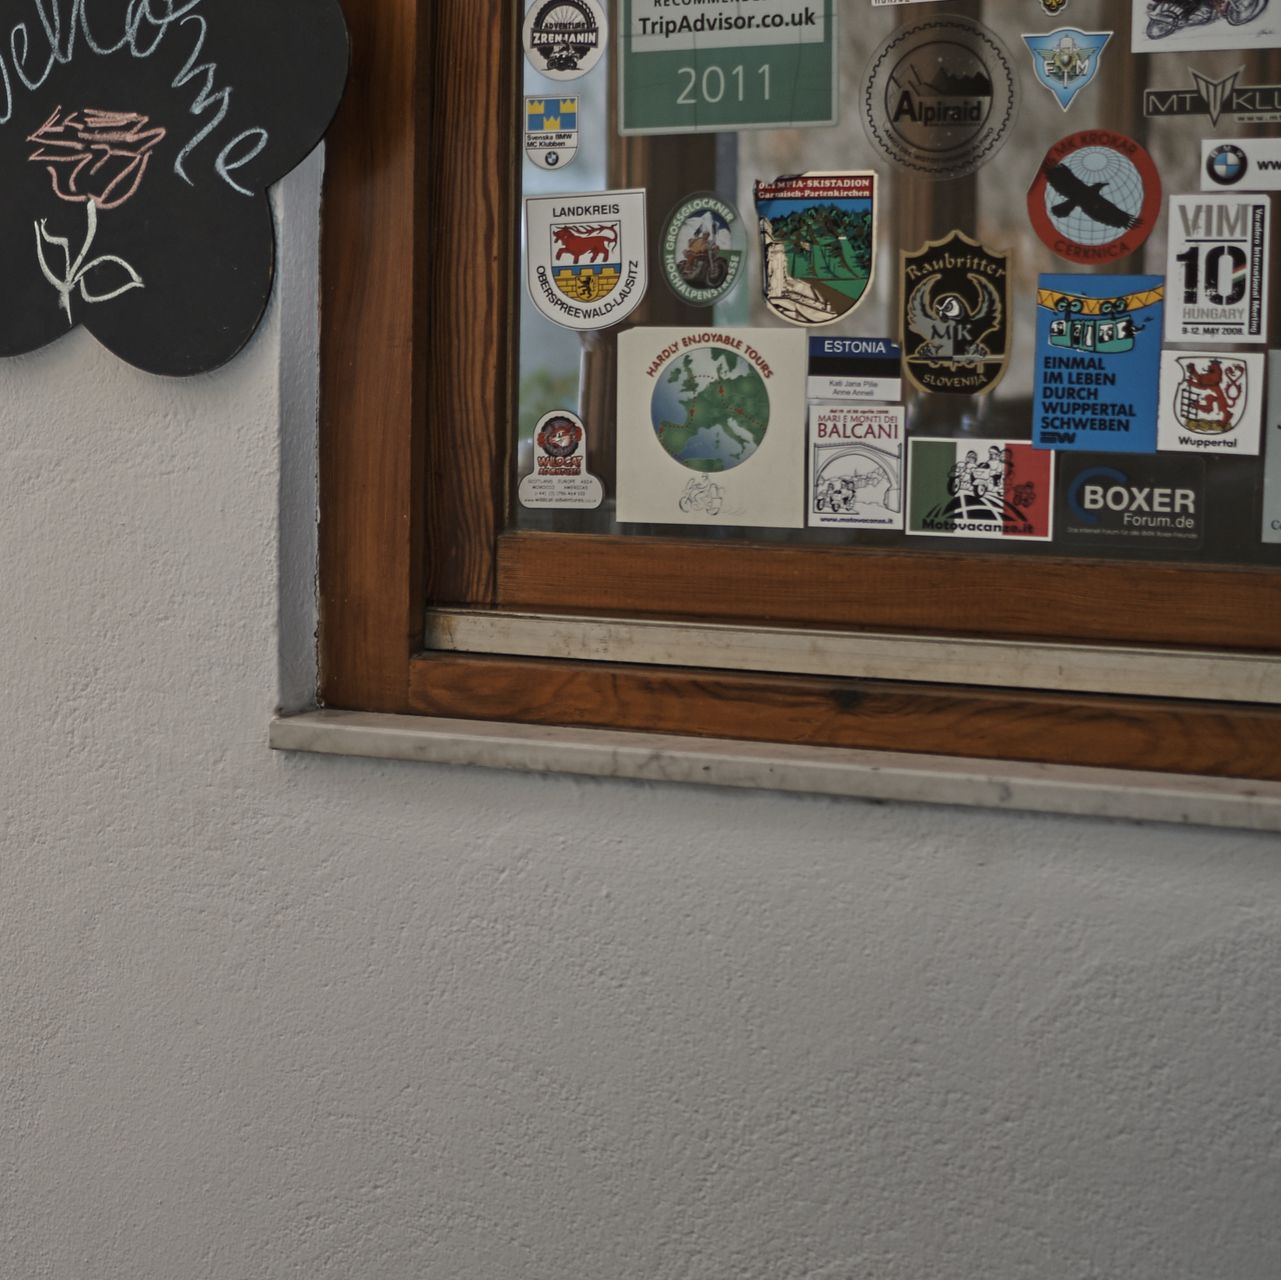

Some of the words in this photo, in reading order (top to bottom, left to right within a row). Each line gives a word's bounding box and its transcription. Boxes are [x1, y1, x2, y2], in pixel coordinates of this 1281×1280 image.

[544, 22, 588, 30] ADVENTURE
[638, 7, 817, 39] TripAdvisor.co.uk
[675, 63, 772, 106] 2011
[892, 90, 982, 127] Alpiraid
[1148, 92, 1199, 113] MT
[552, 204, 621, 218] LANDKREIS
[665, 197, 735, 250] GROSSGLOCKNER
[1178, 203, 1250, 238] VIM
[1253, 207, 1264, 245] Varadero
[1054, 240, 1131, 258] CERKNICA
[906, 253, 1007, 281] Raubritter
[1176, 245, 1248, 306] 10
[1251, 245, 1263, 300] International
[664, 254, 741, 302] HOCHALPENSTRASSE
[536, 260, 639, 320] OBERSPREEWALD-LAUSITZ
[1182, 307, 1246, 321] HUNGARY
[1249, 300, 1261, 334] Meeting
[930, 323, 974, 342] MK
[1202, 327, 1221, 336] MAY
[646, 341, 679, 378] HARDLY
[681, 332, 744, 350] ENJOYABLE
[744, 345, 775, 380] TOURS
[823, 340, 887, 354] ESTONIA
[1043, 356, 1106, 371] EINMAL
[1043, 371, 1063, 384] IM
[1067, 372, 1117, 386] LEBEN
[1042, 387, 1099, 400] DURCH
[1041, 402, 1137, 417] WUPPERTAL
[817, 422, 898, 439] BALCANI
[1040, 416, 1130, 432] SCHWEBEN
[1178, 436, 1238, 449] Wuppertal
[537, 455, 584, 468] WILDCAT
[1083, 485, 1197, 514] BOXER
[922, 518, 1035, 534] Motovacanze.it
[1123, 513, 1196, 529] Forum.de
